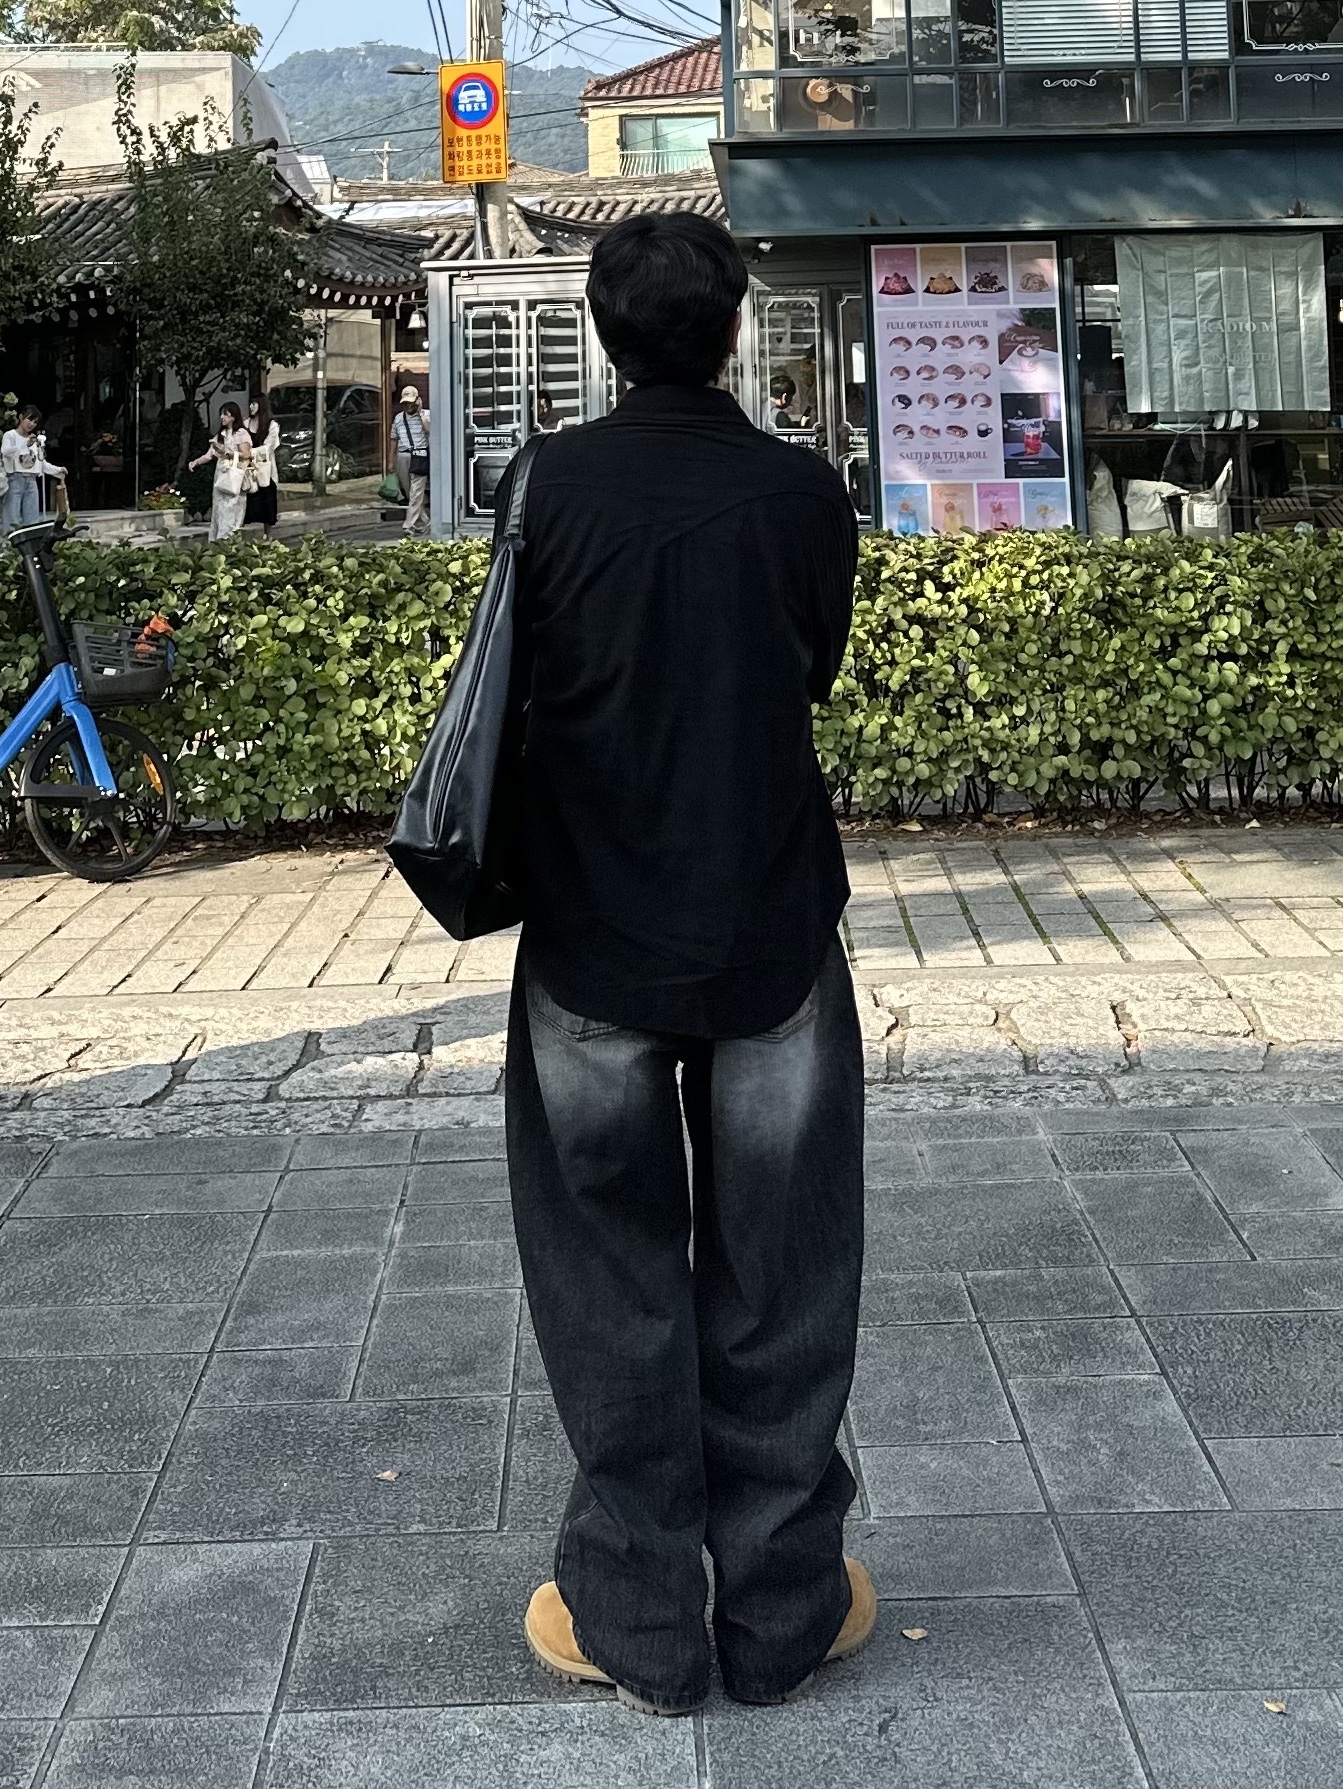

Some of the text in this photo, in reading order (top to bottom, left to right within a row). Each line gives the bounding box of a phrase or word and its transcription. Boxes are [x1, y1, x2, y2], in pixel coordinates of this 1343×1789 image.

[886, 319, 989, 330] FULL OF TASTE & FLAVOUR
[1201, 320, 1276, 333] RADIO M
[899, 450, 988, 460] SALTED BUTTER ROLL
